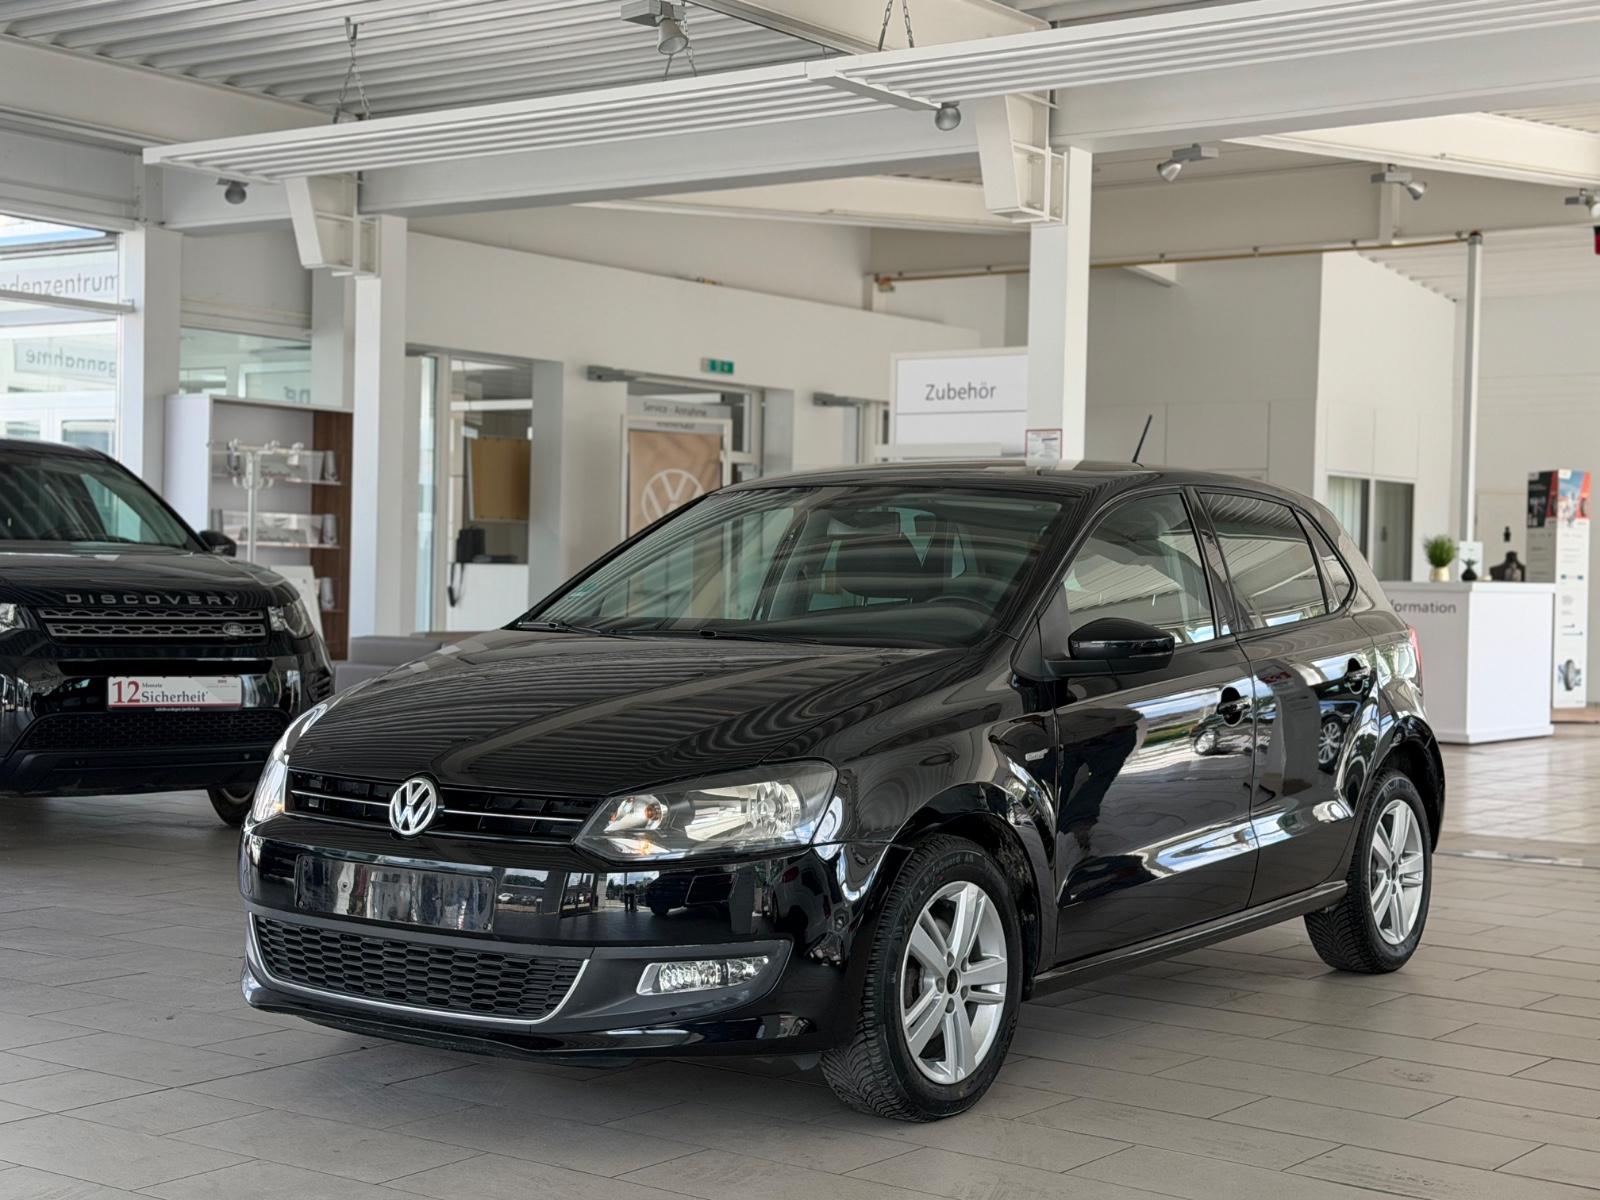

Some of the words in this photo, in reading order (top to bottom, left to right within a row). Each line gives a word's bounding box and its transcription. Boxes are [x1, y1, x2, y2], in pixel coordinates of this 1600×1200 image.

[925, 382, 997, 401] Zubehör
[65, 594, 239, 605] DISCOVERY
[112, 680, 141, 704] 12
[389, 777, 437, 836] VW
